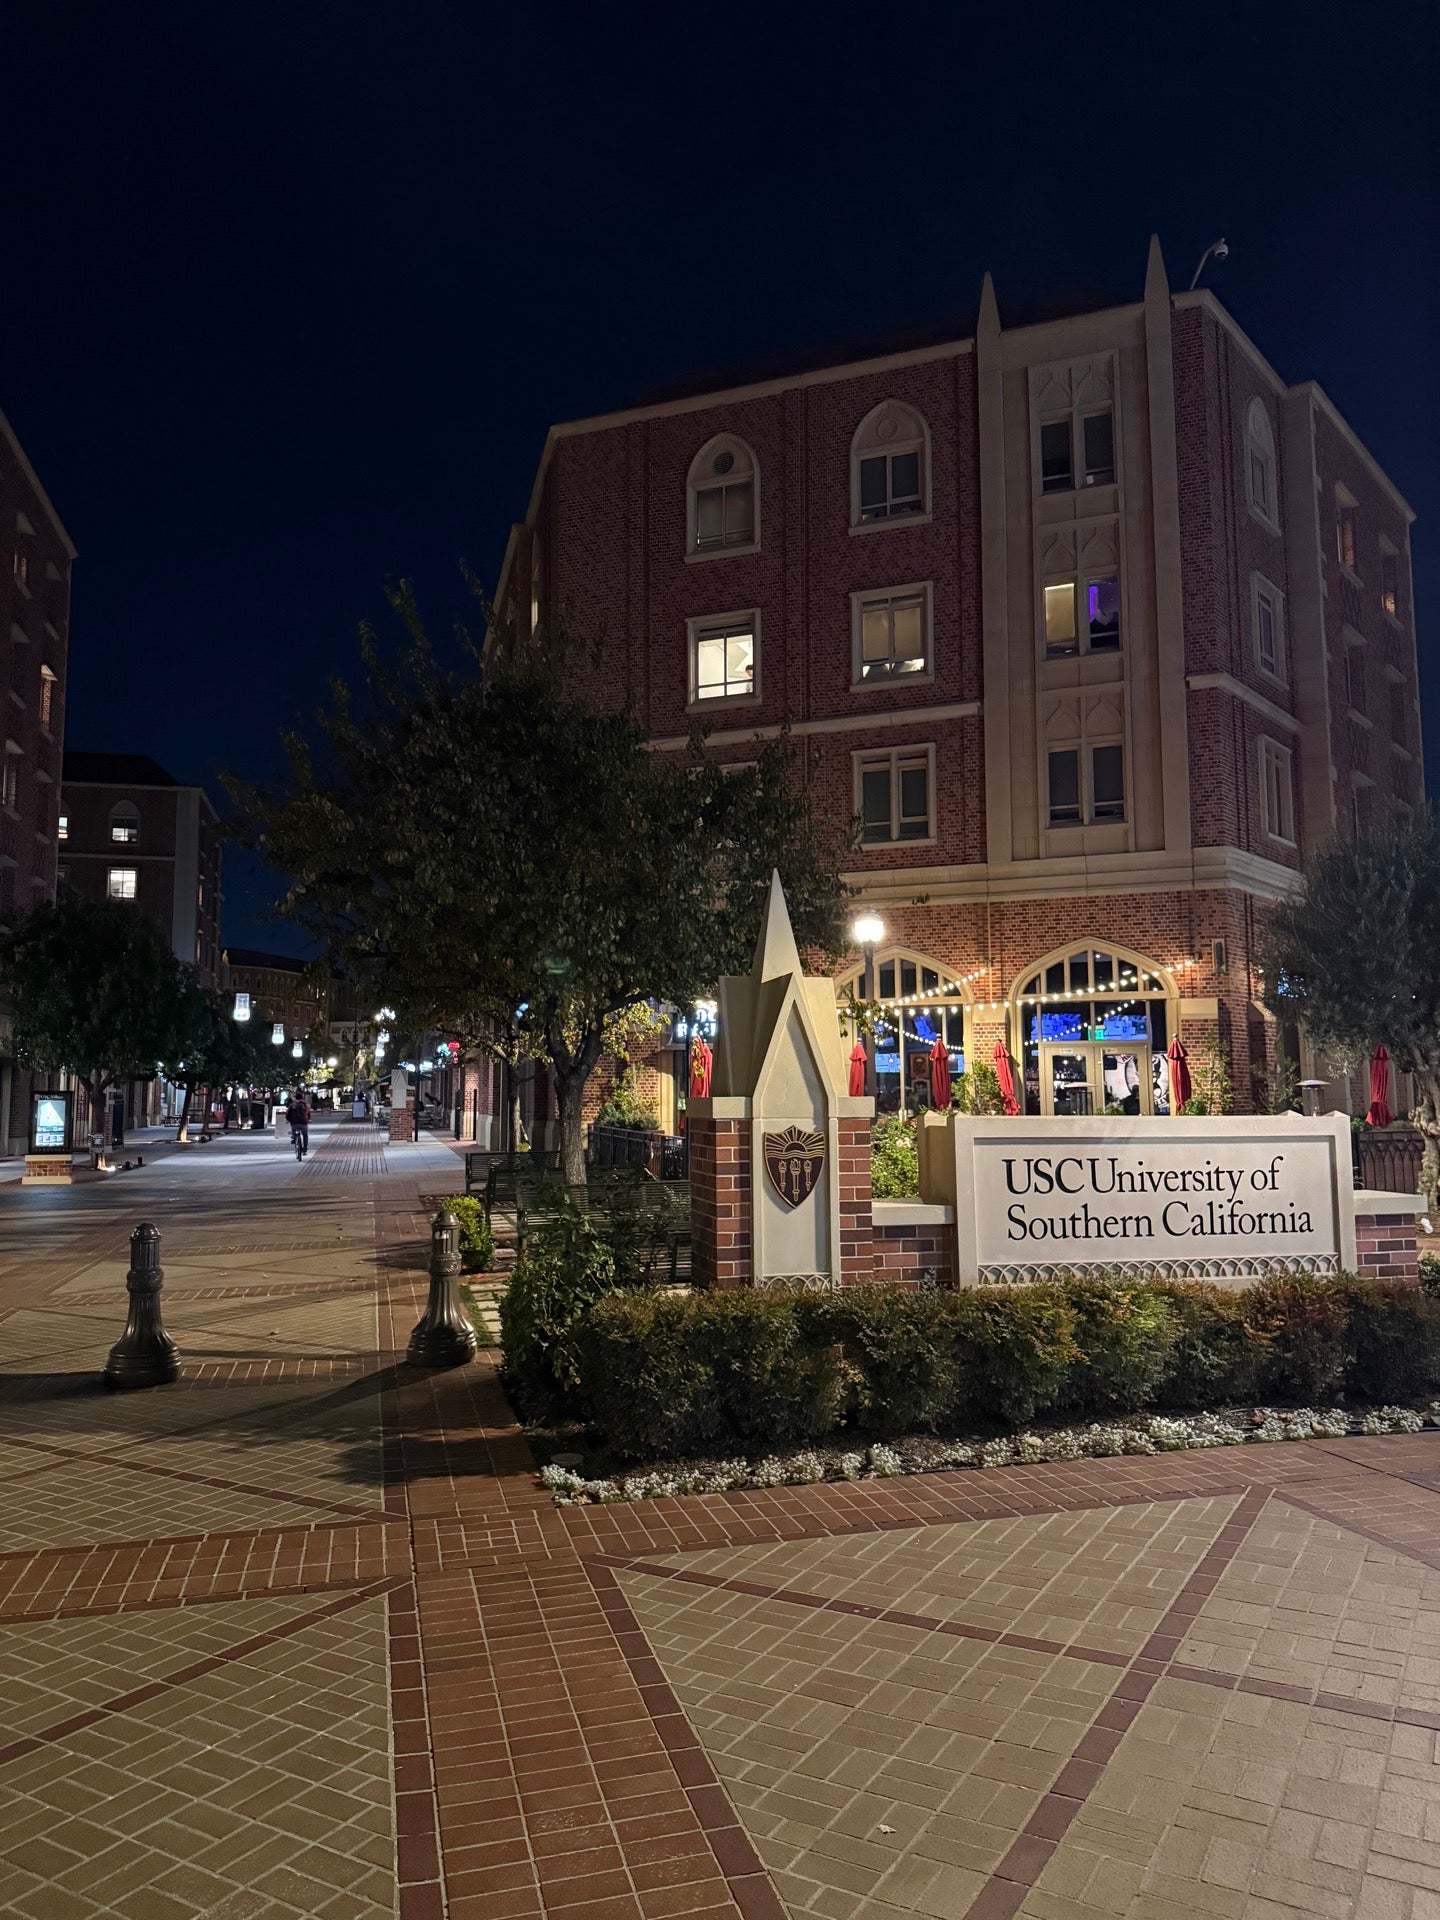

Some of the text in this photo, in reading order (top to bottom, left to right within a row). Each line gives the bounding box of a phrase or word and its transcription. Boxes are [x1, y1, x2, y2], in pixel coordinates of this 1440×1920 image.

[1002, 1155, 1284, 1203] USC University of
[1007, 1199, 1314, 1241] Southern California
